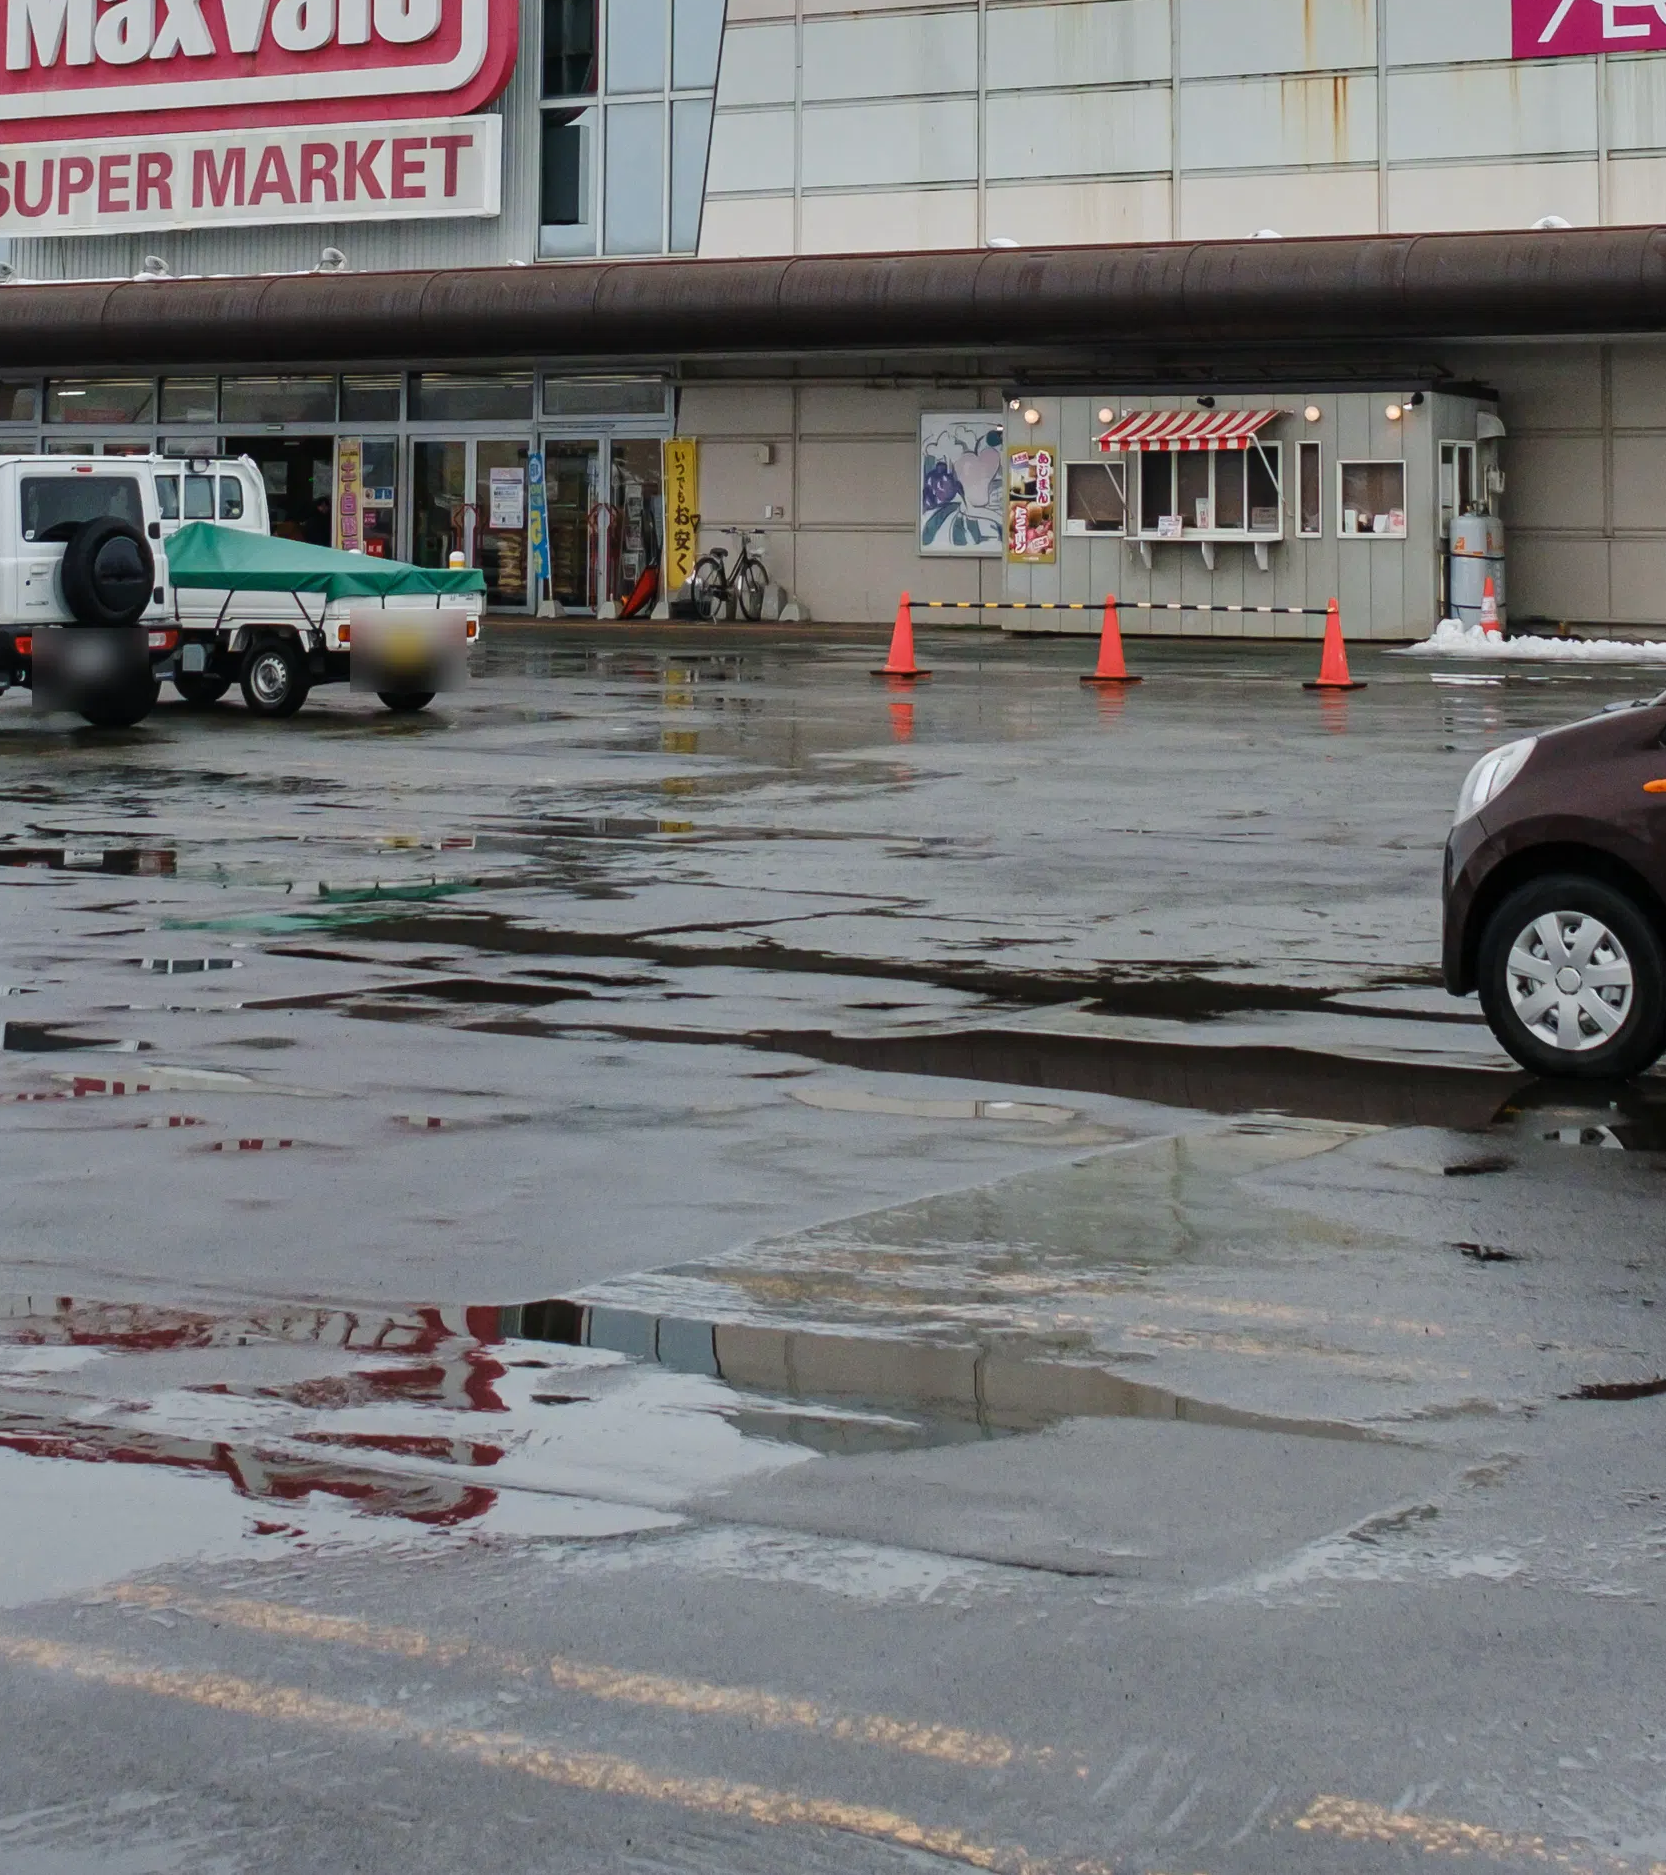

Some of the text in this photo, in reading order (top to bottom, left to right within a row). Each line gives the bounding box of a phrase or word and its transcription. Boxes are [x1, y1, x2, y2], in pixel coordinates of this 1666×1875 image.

[191, 133, 474, 209] MARKET
[673, 450, 691, 576] いつでもお安く
[1037, 451, 1050, 505] あじまん
